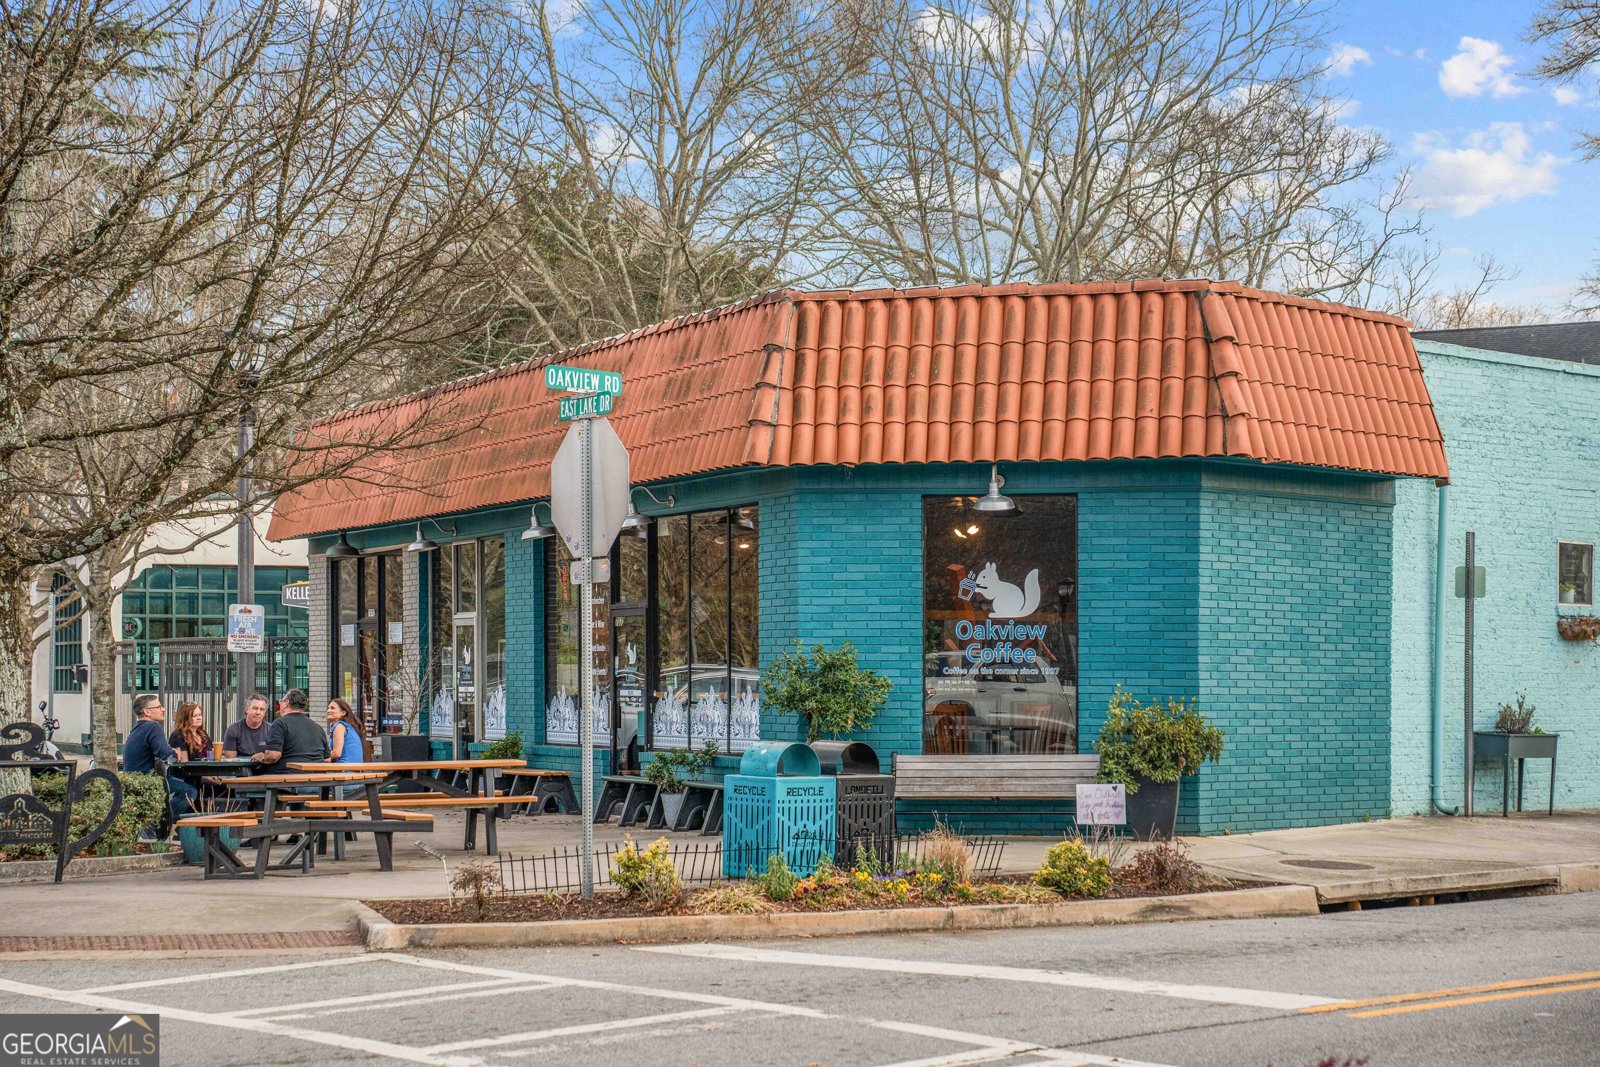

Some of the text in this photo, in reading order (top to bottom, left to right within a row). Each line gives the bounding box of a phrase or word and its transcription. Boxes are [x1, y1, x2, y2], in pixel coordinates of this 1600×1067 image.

[548, 368, 620, 393] OAKVIEW RD
[560, 394, 610, 418] EAST LAKE DR
[955, 619, 1048, 640] Oakview
[965, 642, 1037, 663] Coffee
[942, 666, 968, 675] Coffee
[968, 667, 980, 675] on
[980, 666, 993, 675] the
[994, 667, 1019, 675] corner
[1020, 666, 1039, 675] since
[733, 784, 766, 796] RECYCLE
[786, 786, 824, 797] RECYCLE
[844, 785, 885, 795] LANDFILL
